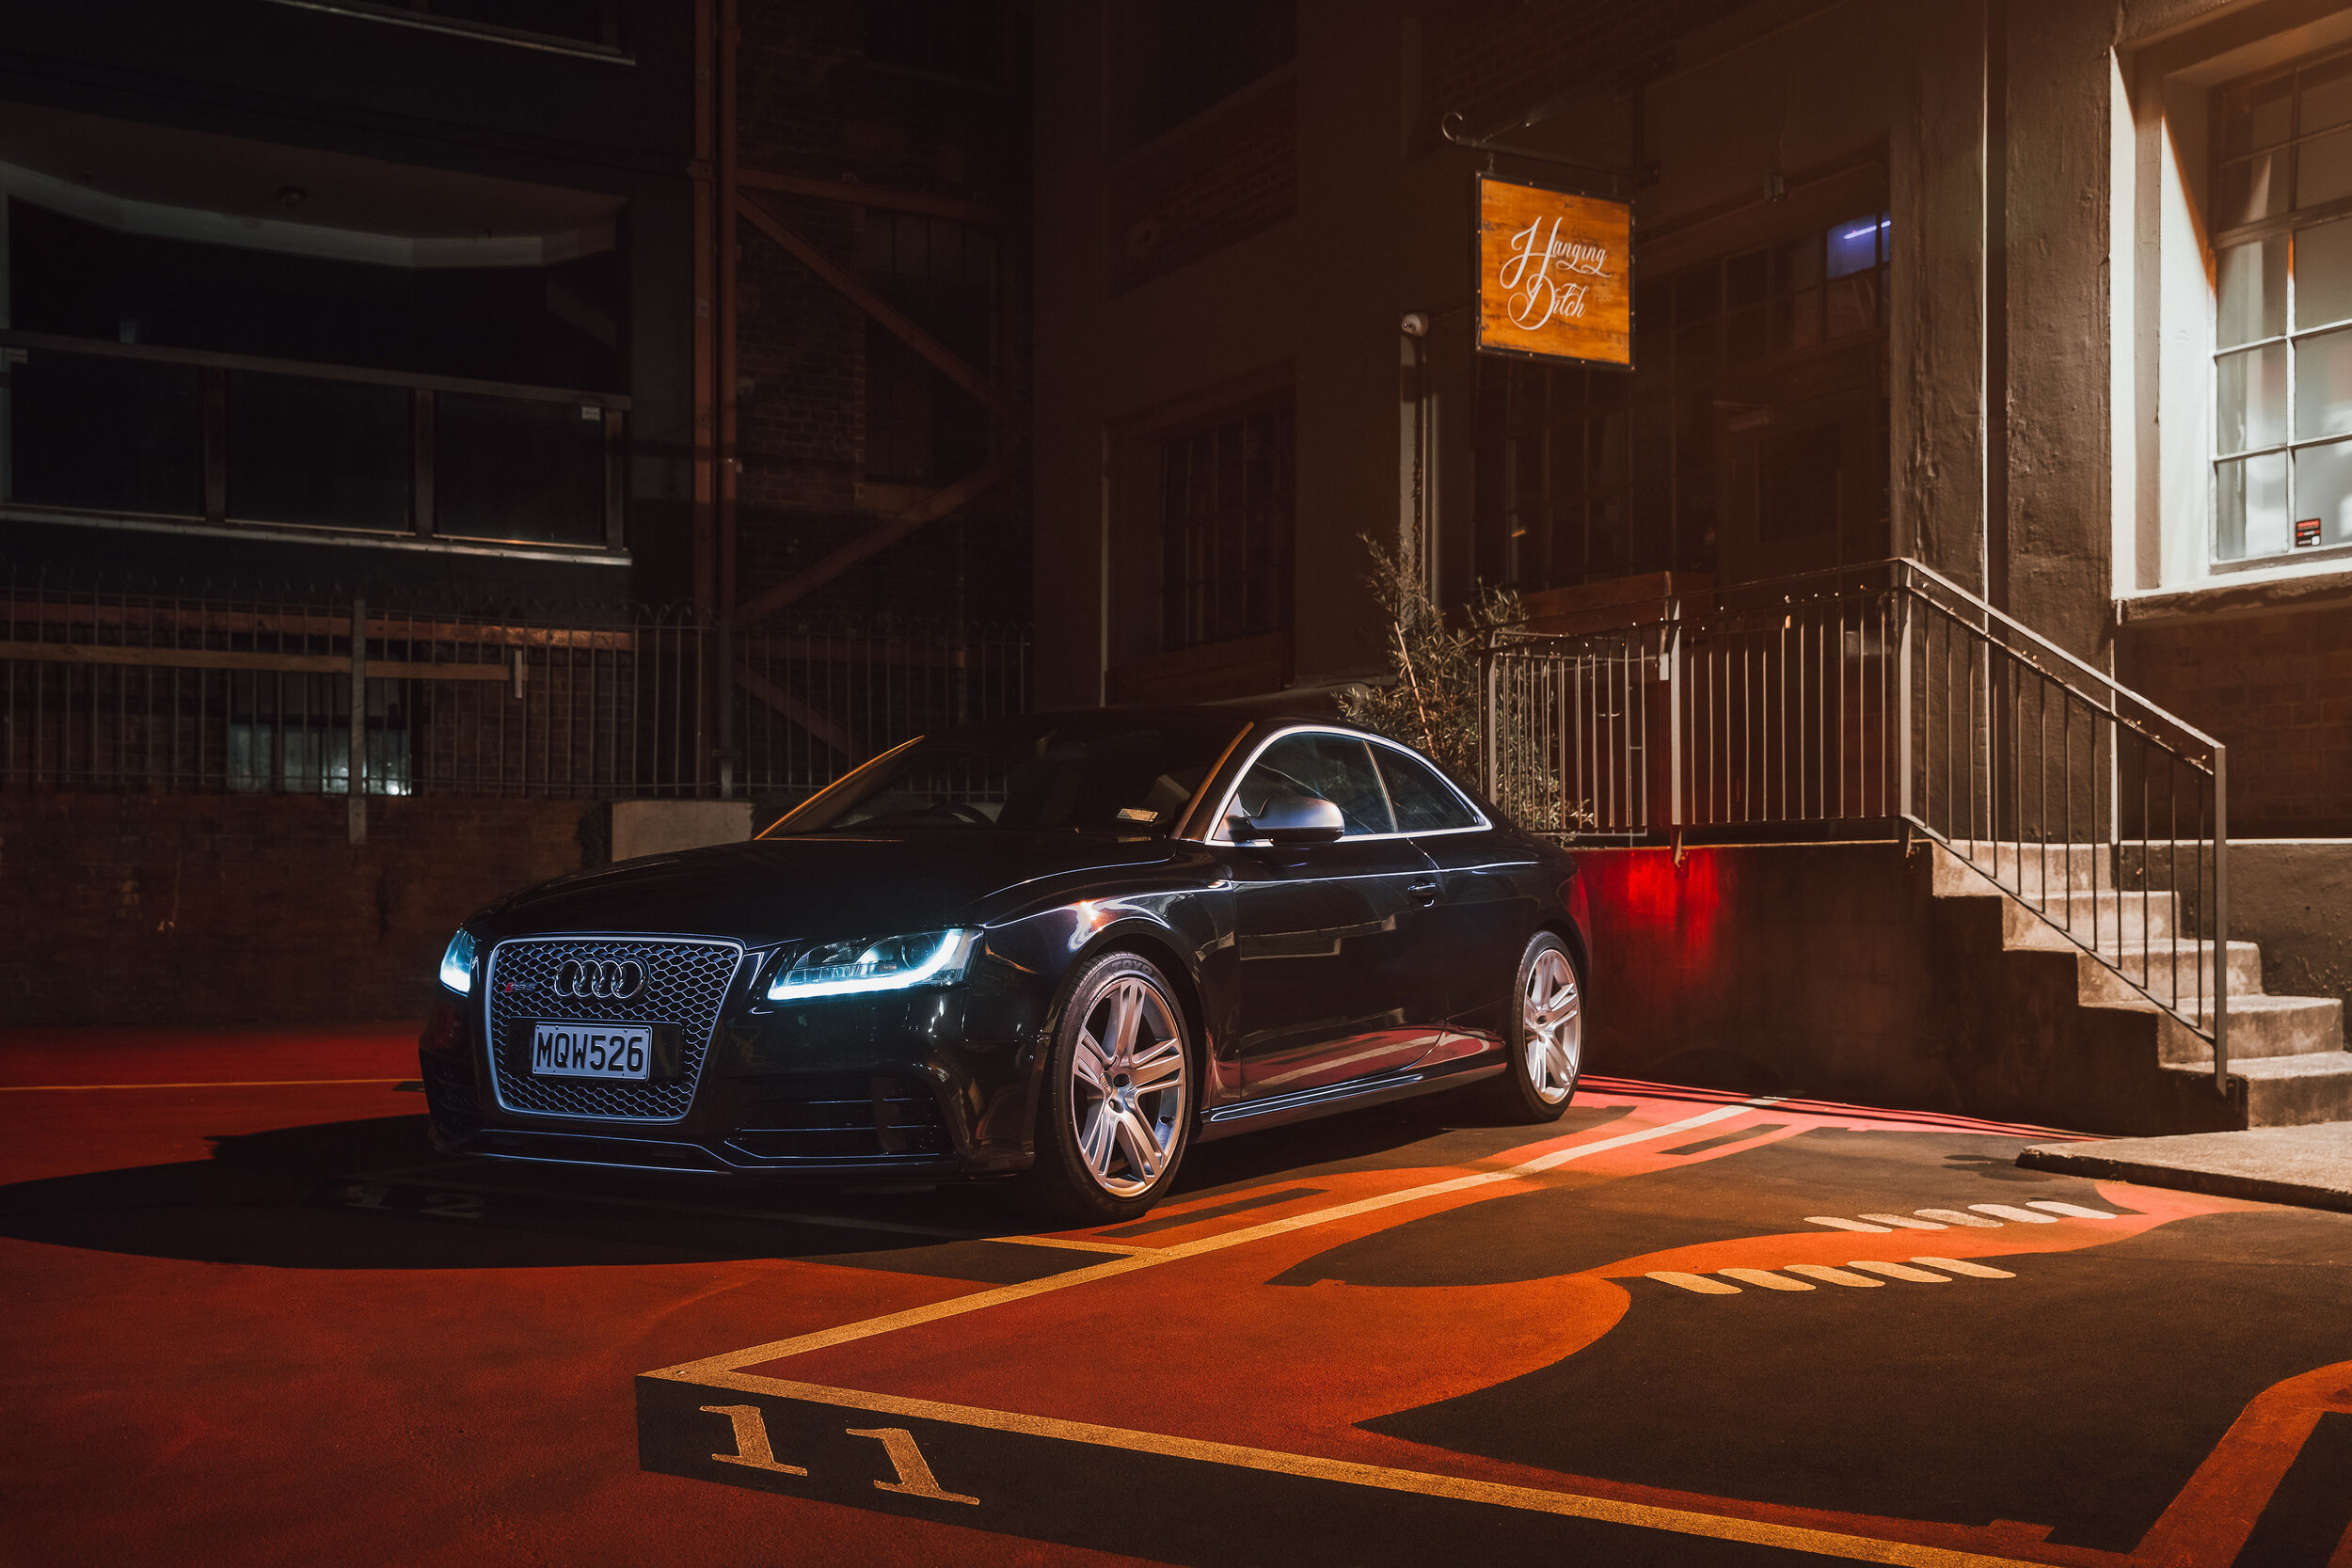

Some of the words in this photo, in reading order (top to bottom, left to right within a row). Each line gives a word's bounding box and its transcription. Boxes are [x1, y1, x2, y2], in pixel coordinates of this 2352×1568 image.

[1500, 216, 1613, 290] Hanging
[1508, 274, 1589, 330] Ditch
[1111, 959, 1152, 974] TOYO
[535, 1032, 644, 1073] MQW526
